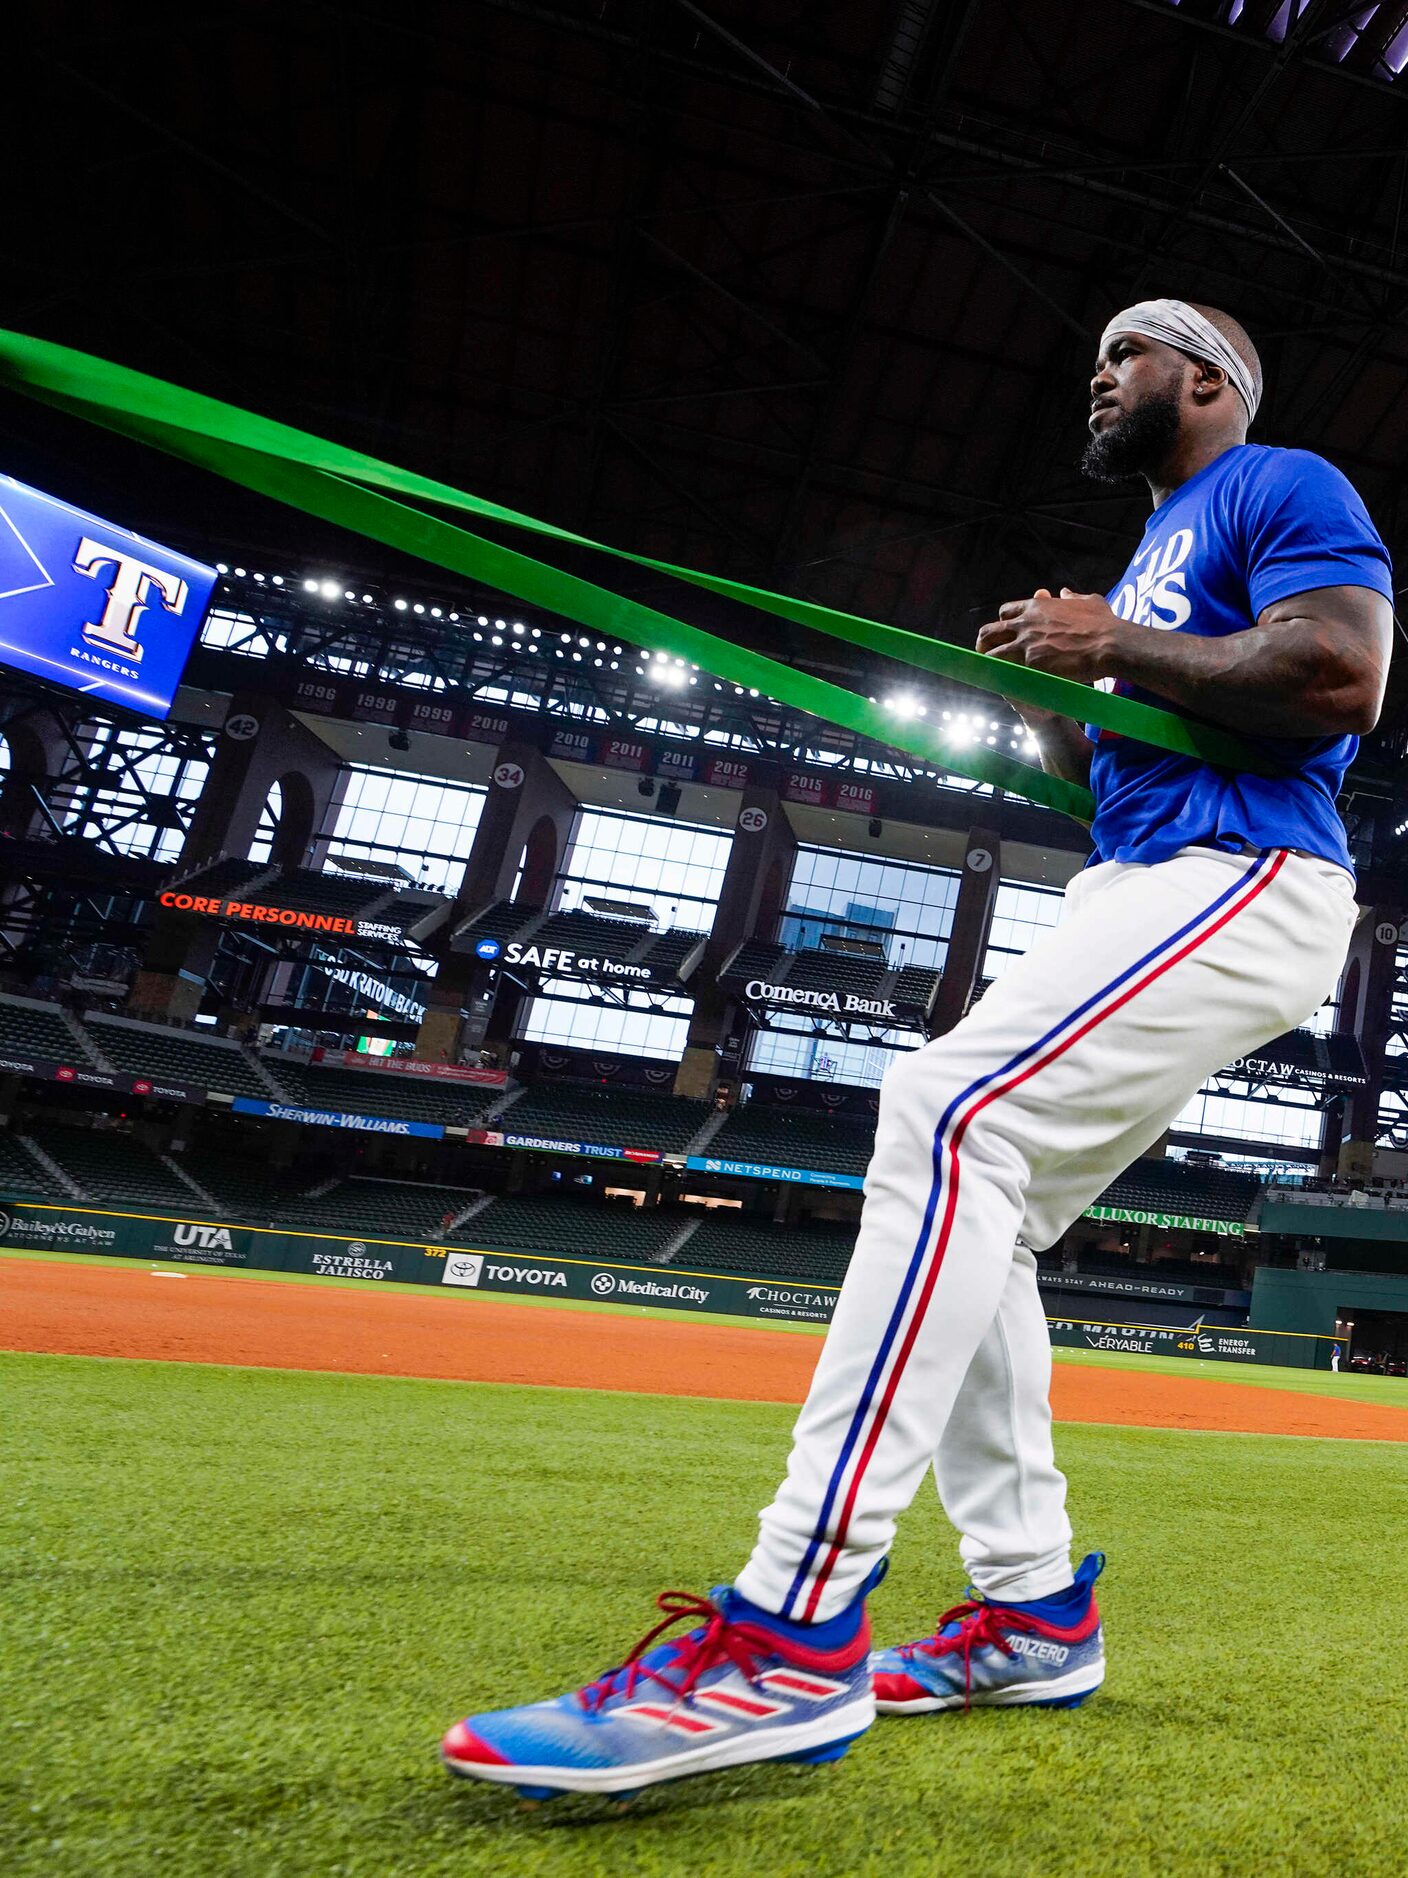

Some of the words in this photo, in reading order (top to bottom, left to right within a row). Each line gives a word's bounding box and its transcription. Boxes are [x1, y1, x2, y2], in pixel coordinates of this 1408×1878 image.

[71, 536, 189, 665] T
[70, 647, 139, 680] RANGERS
[297, 682, 336, 700] 1996
[357, 694, 397, 712] 1998
[413, 704, 453, 722] 1999
[228, 719, 255, 734] 42
[472, 715, 508, 733] 2010
[554, 731, 590, 748] 2010
[609, 741, 643, 759] 2011
[662, 751, 695, 768] 2011
[497, 767, 521, 785] 34
[714, 760, 748, 777] 2012
[790, 775, 822, 792] 2015
[839, 784, 873, 801] 2016
[742, 812, 764, 828] 26
[975, 853, 986, 868] 7
[159, 892, 221, 914] CORE
[225, 902, 355, 935] PERSONNEL
[357, 921, 402, 935] STAFFING
[357, 928, 400, 942] SERVICES
[1379, 928, 1393, 940] 10
[504, 942, 576, 972] SAFE
[578, 957, 599, 970] at
[602, 959, 651, 979] home
[844, 994, 897, 1017] Bank
[0, 1059, 34, 1072] OYOTA
[1232, 1057, 1295, 1075] OCTAW
[1295, 1069, 1326, 1079] CASINOS
[1335, 1075, 1366, 1084] RESORTS
[77, 1072, 114, 1086] TOYOTA
[153, 1085, 186, 1099] TOYOTA
[506, 1136, 581, 1153] GARDENERS
[584, 1144, 622, 1158] TRUST
[724, 1163, 802, 1180] NETSPEND
[1100, 1207, 1158, 1225] LUXOR
[1158, 1214, 1241, 1235] STAFFING
[173, 1224, 233, 1250] UTA
[424, 1247, 447, 1258] 372
[312, 1254, 393, 1272] ESTRELLA
[316, 1265, 385, 1281] JALISCO
[486, 1264, 568, 1288] TOYOTA
[1065, 1278, 1084, 1286] STAY
[1089, 1280, 1185, 1296] AHEAD-READY
[754, 1286, 837, 1307] CHOCTAW
[760, 1306, 790, 1316] CASINOS
[798, 1310, 827, 1320] RESORTS
[1177, 1341, 1194, 1350] 410
[1217, 1346, 1256, 1356] TRANSFER
[1218, 1338, 1249, 1347] ENERGY
[1005, 1634, 1069, 1663] ADIZERO
